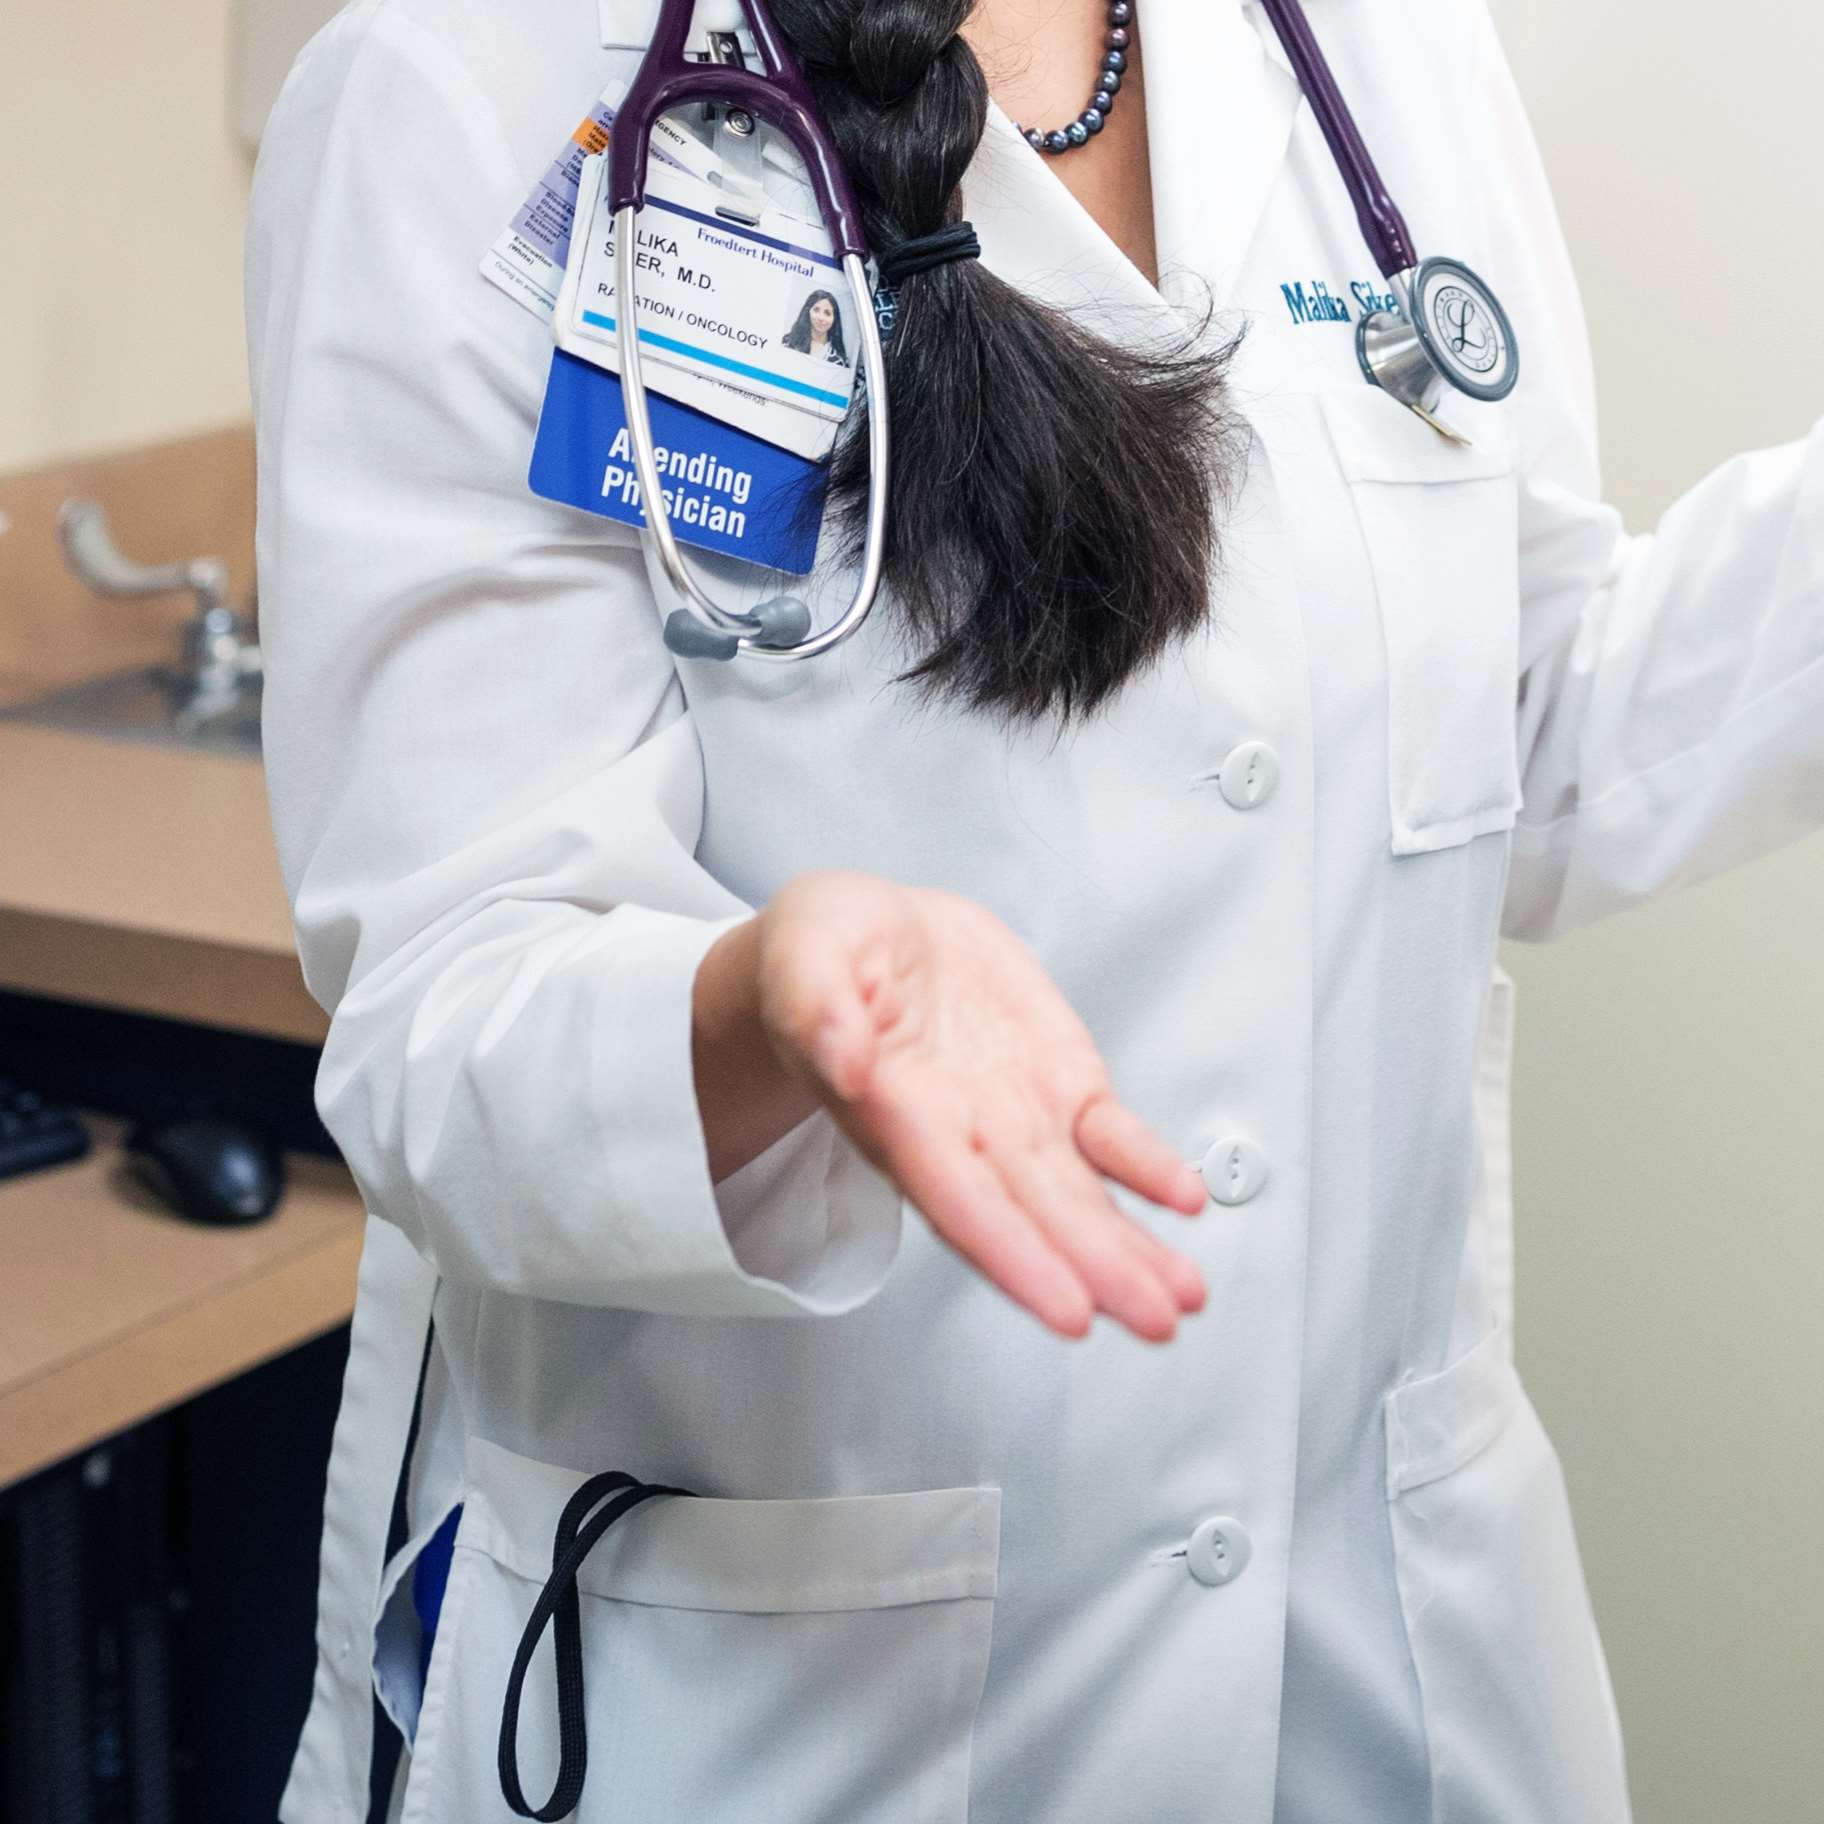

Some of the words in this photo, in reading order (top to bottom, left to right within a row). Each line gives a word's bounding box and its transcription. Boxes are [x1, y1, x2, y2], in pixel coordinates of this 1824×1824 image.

[608, 219, 679, 258] LIKA
[697, 226, 757, 259] Froedtert
[760, 249, 815, 279] Hospital
[603, 241, 666, 278] SER,
[676, 266, 716, 293] M.D.
[597, 282, 676, 319] RAATION
[686, 312, 768, 350] ONCOLOGY
[1279, 280, 1352, 325] Malika
[607, 427, 753, 505] Aending
[601, 464, 746, 539] Phsician
